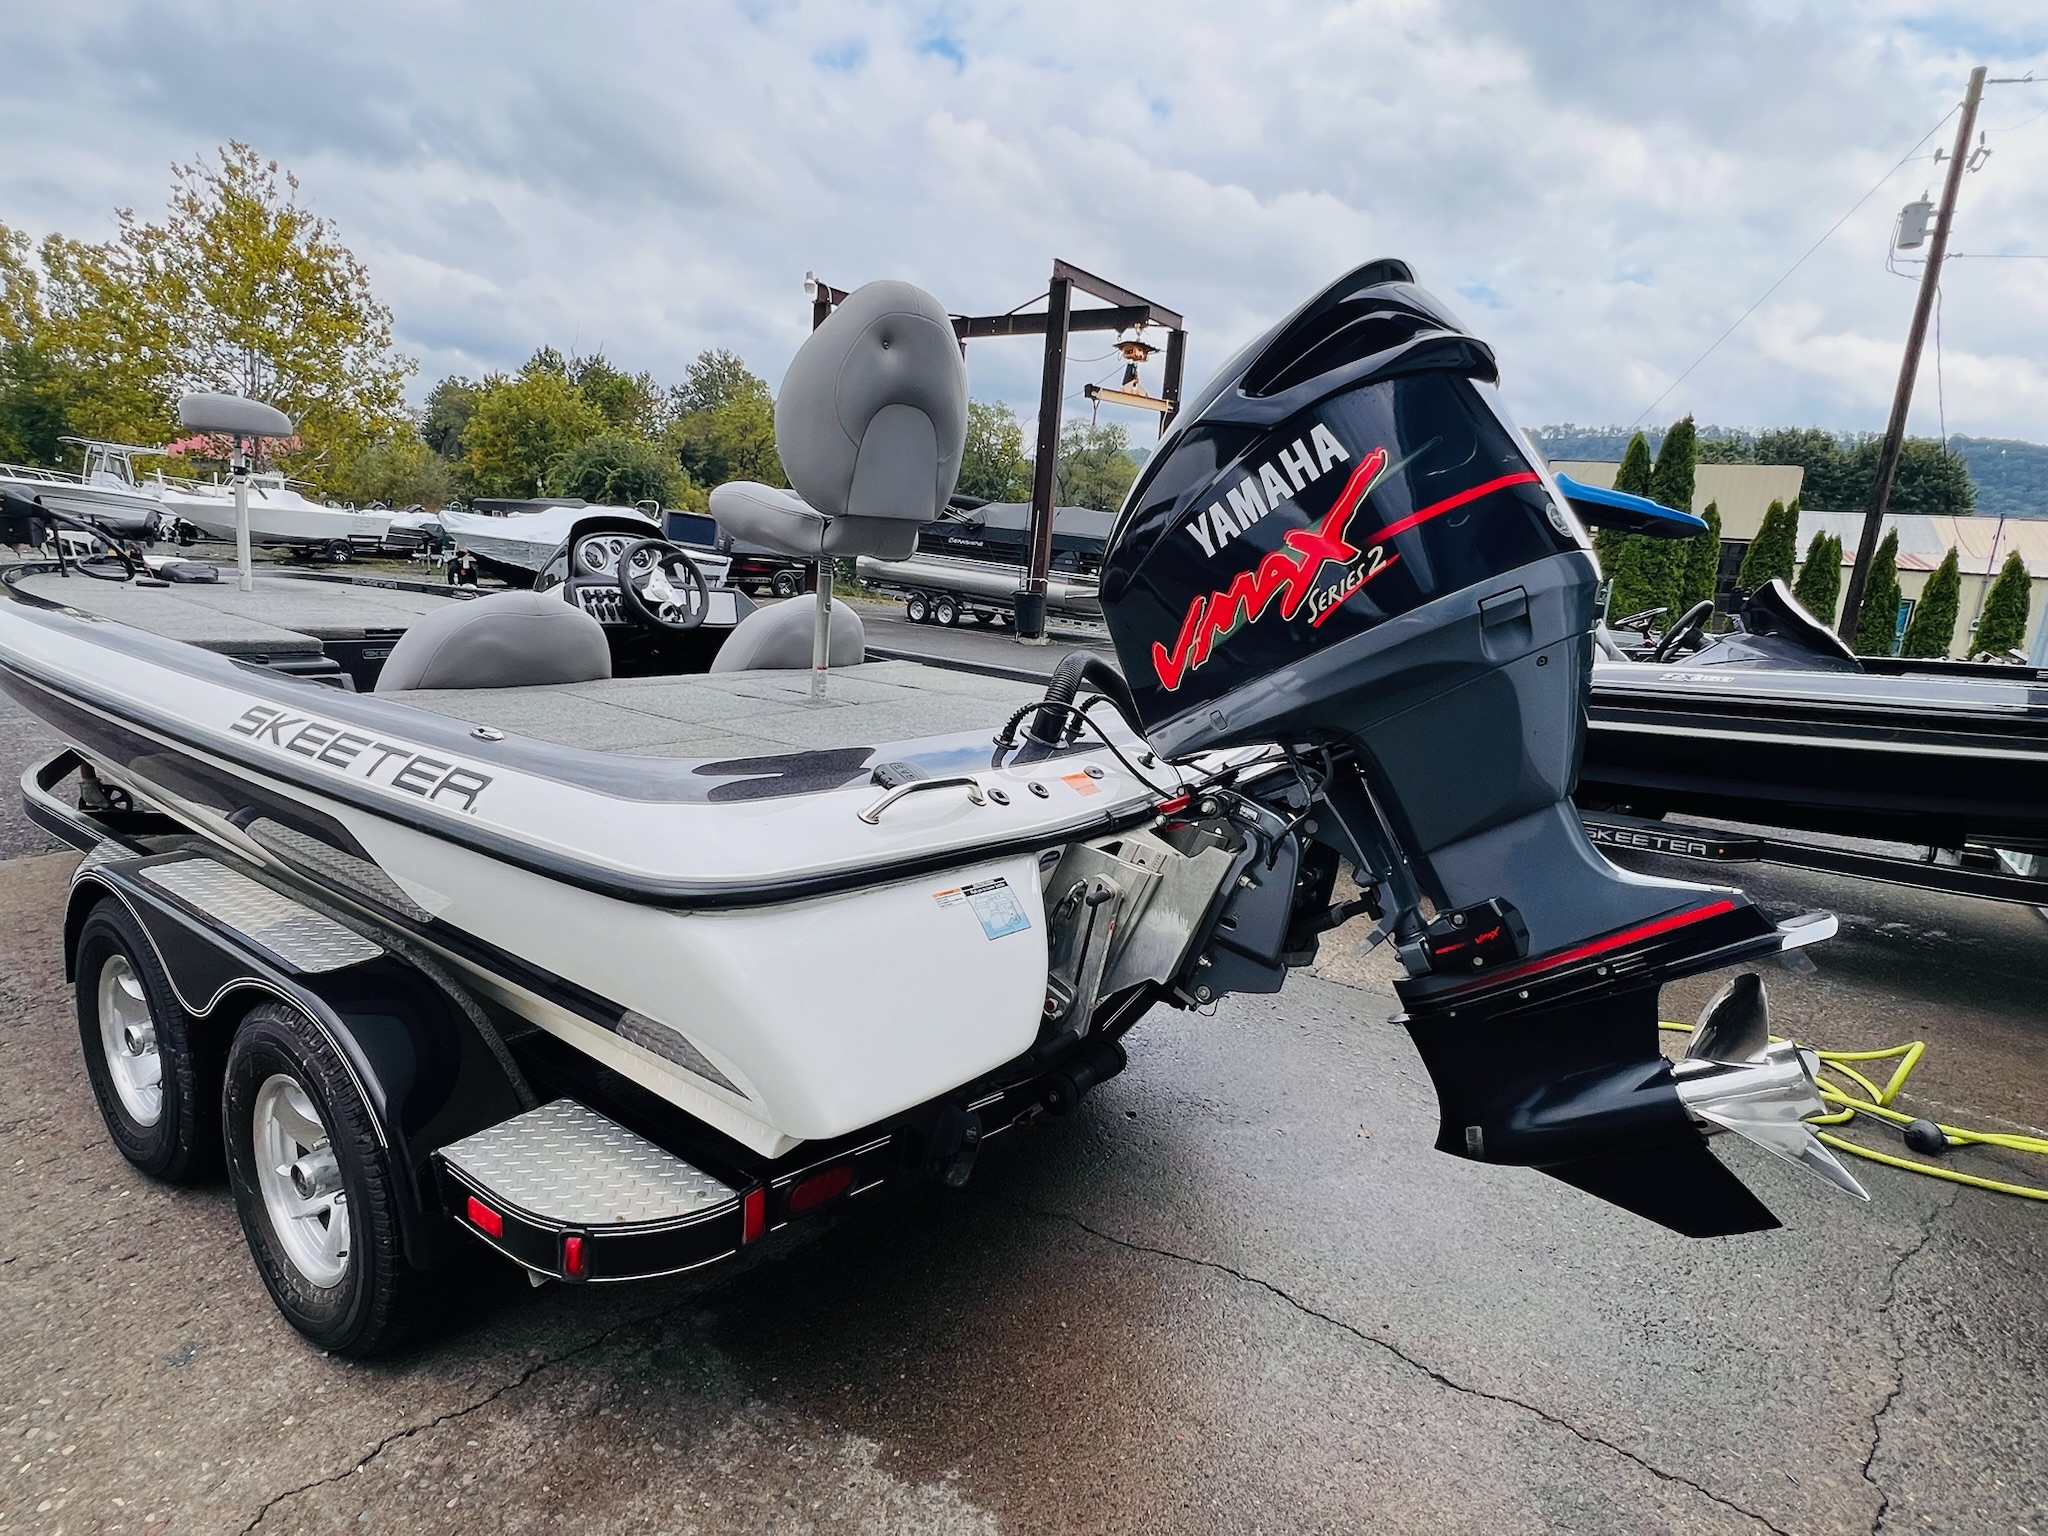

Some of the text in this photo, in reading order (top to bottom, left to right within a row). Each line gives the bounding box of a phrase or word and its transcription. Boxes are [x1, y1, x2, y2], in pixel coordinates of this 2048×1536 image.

[1186, 422, 1351, 559] YAMAHA
[1362, 545, 1387, 579] 2
[229, 705, 494, 815] SKEETER
[893, 764, 916, 780] GAS
[1584, 826, 1707, 856] SKEETER
